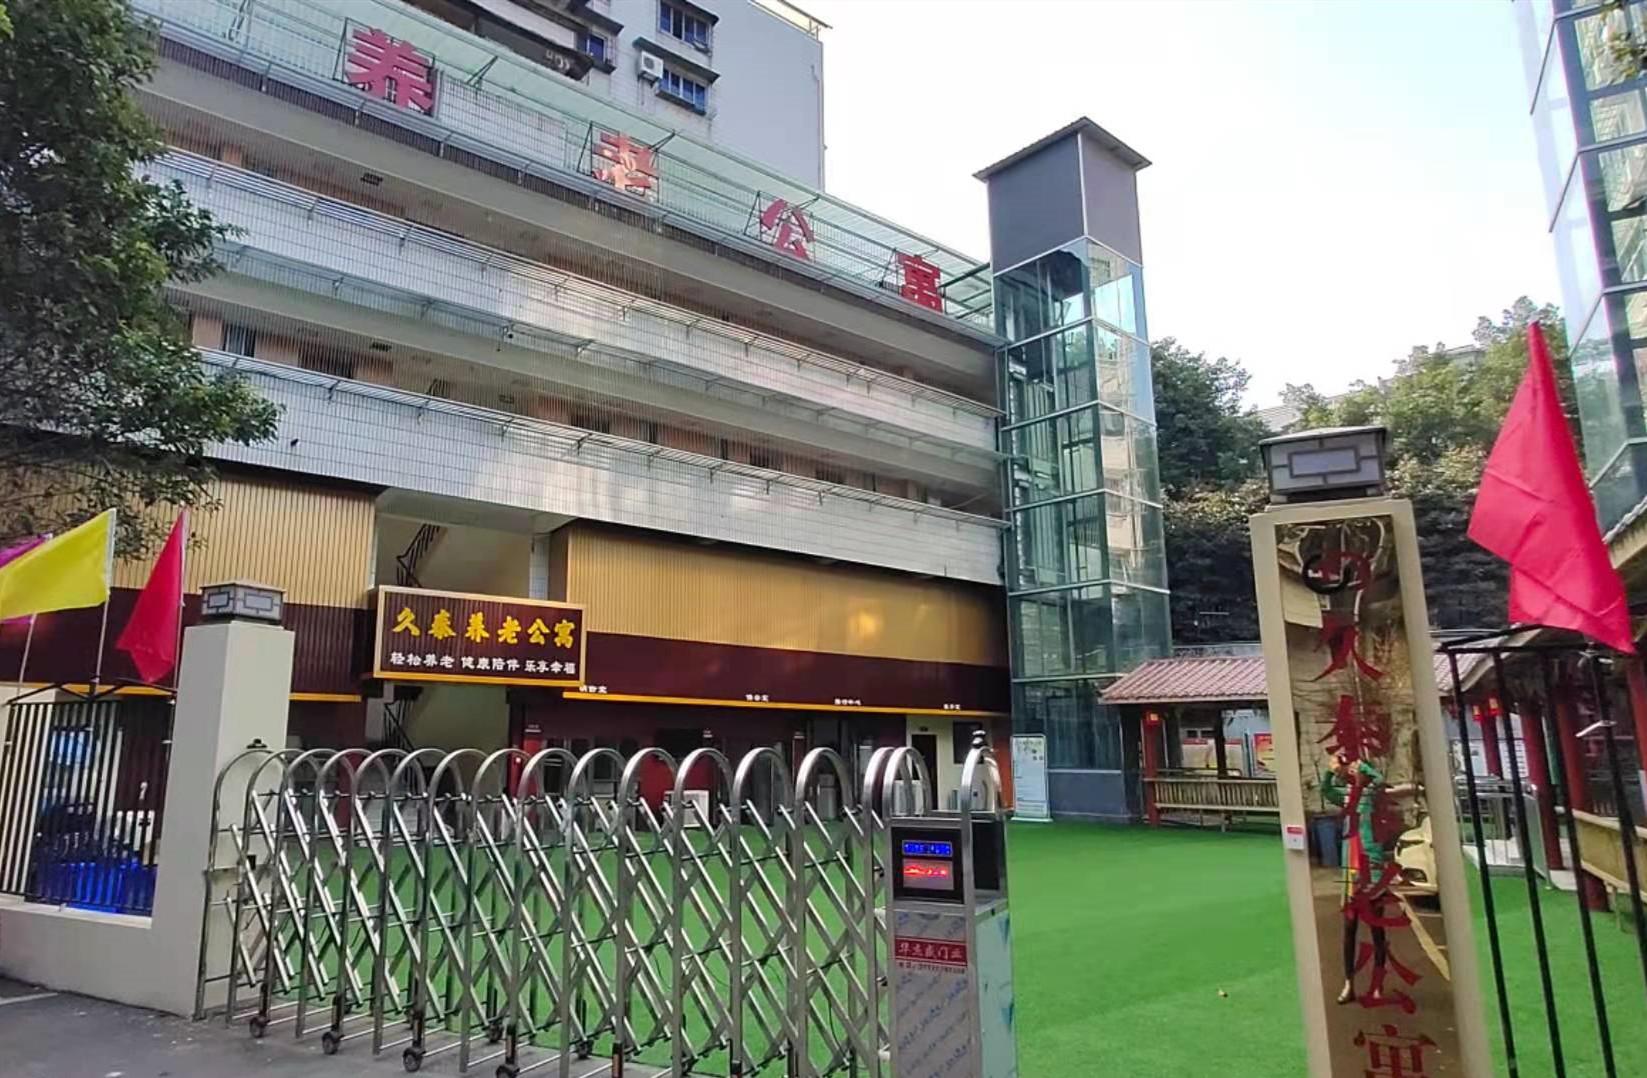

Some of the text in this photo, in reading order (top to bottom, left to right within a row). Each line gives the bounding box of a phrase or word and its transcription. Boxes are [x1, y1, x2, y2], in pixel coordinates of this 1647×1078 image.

[393, 607, 575, 648] 久泰养老公寓
[391, 652, 576, 674] 轻松养老 健康陪伴 乐享幸福
